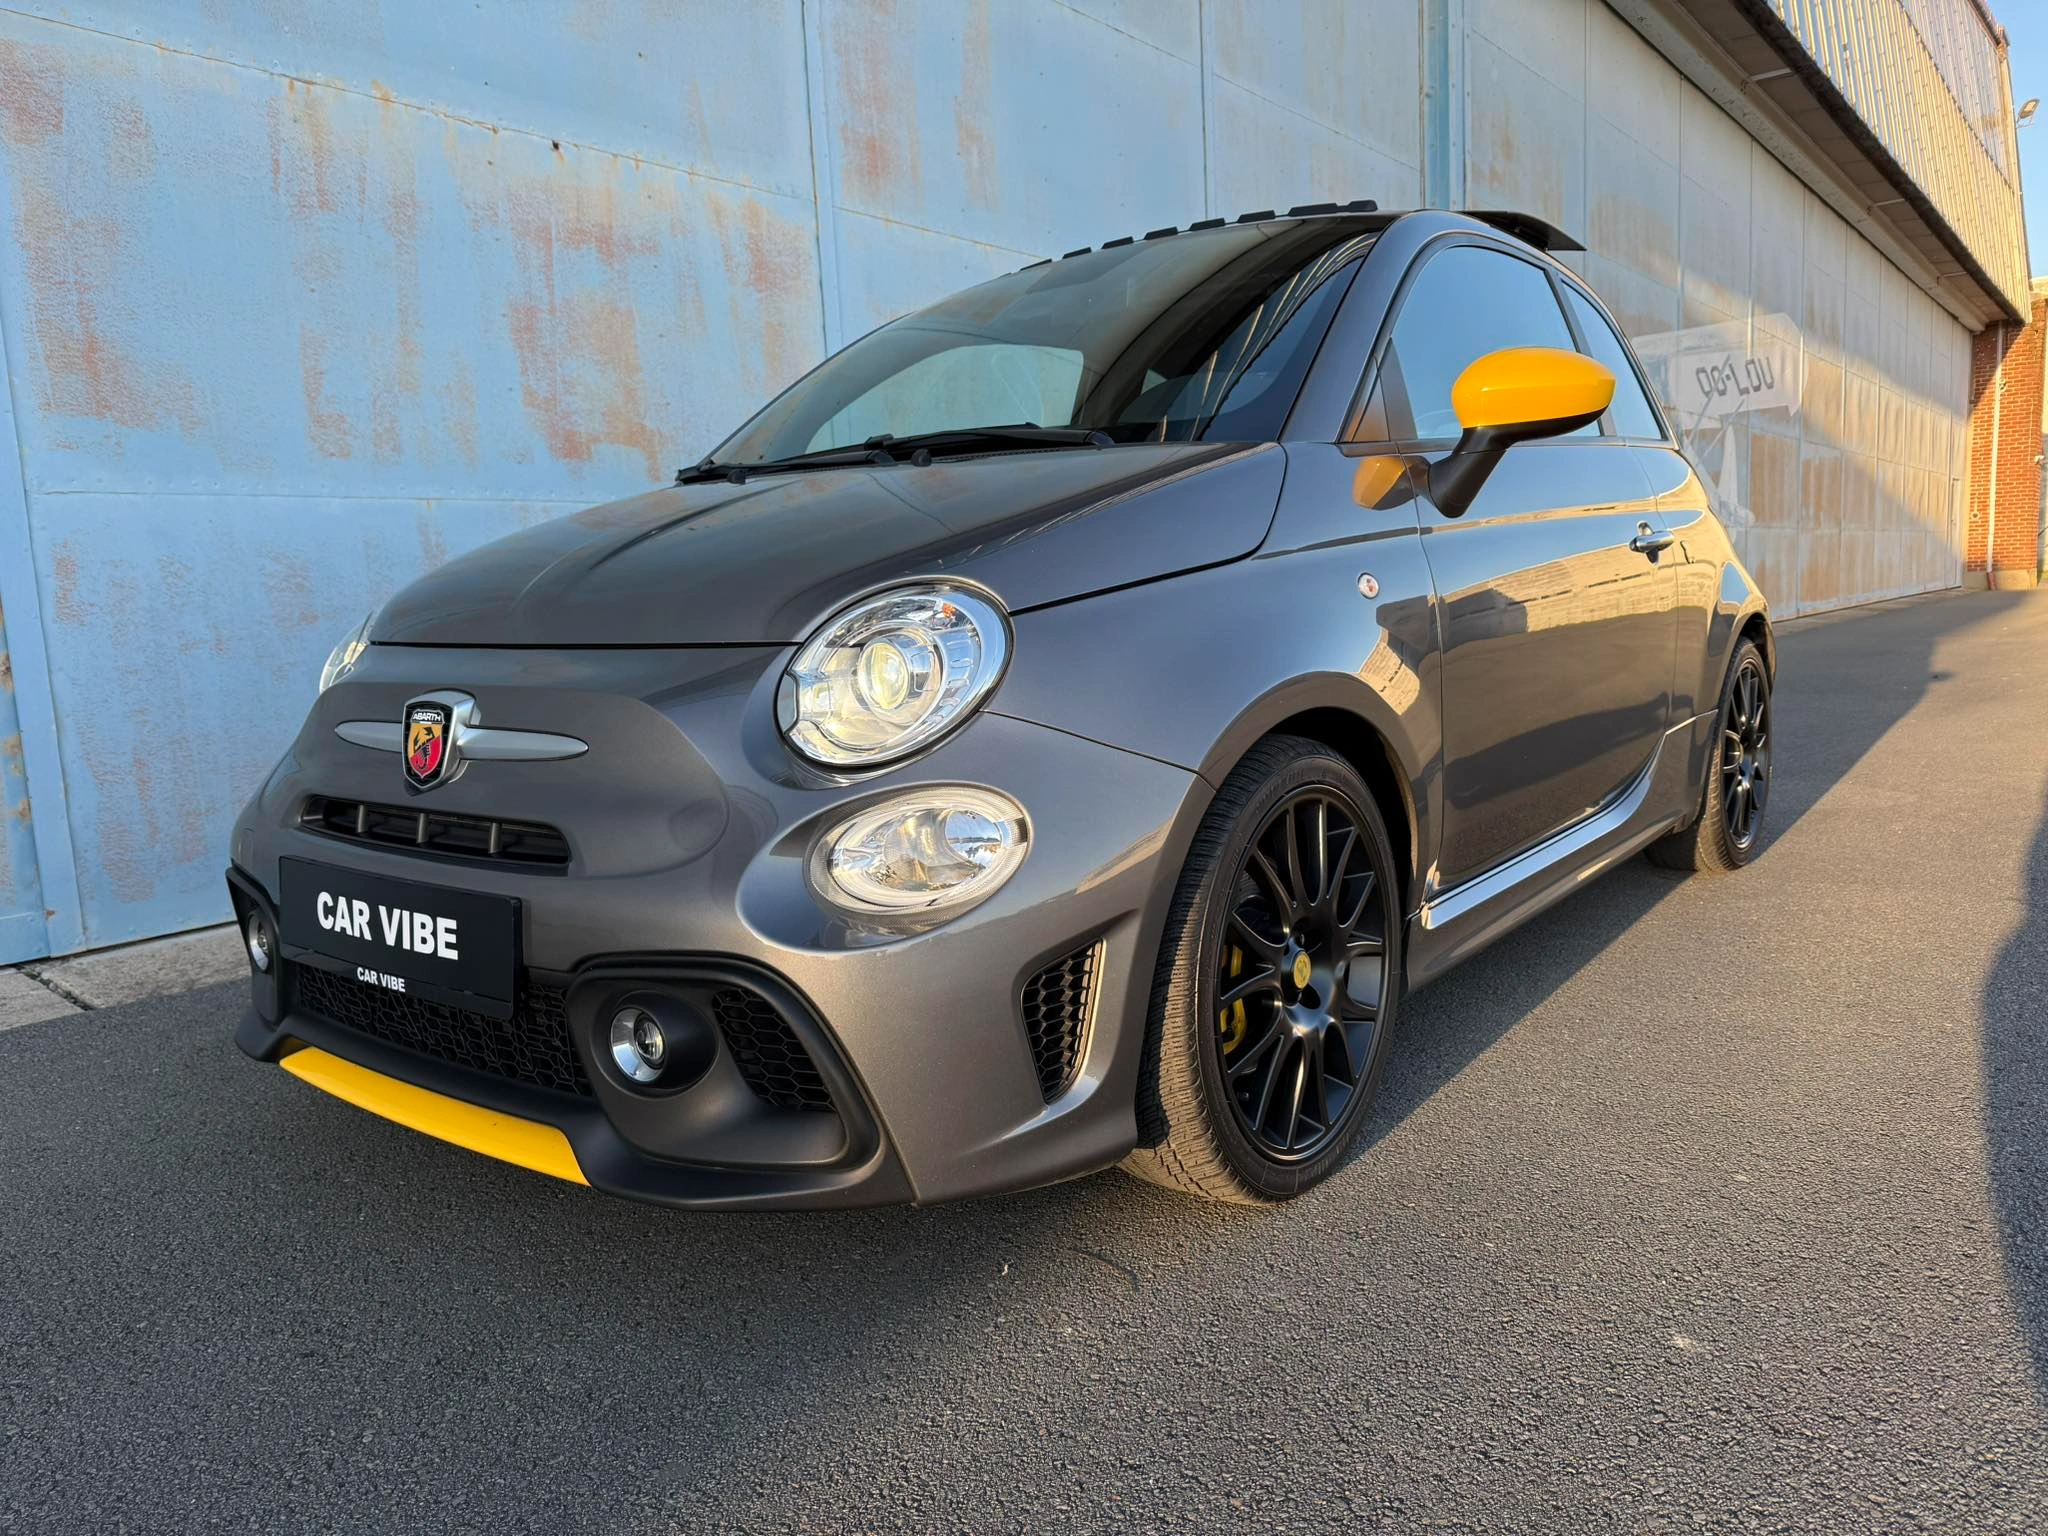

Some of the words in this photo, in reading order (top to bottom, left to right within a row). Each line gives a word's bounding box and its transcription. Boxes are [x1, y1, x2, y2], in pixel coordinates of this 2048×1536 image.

[412, 712, 441, 721] ABARTH
[316, 891, 372, 940] CAR
[378, 904, 459, 961] VIBE
[356, 966, 379, 986] CAR
[380, 973, 406, 993] VIBE
